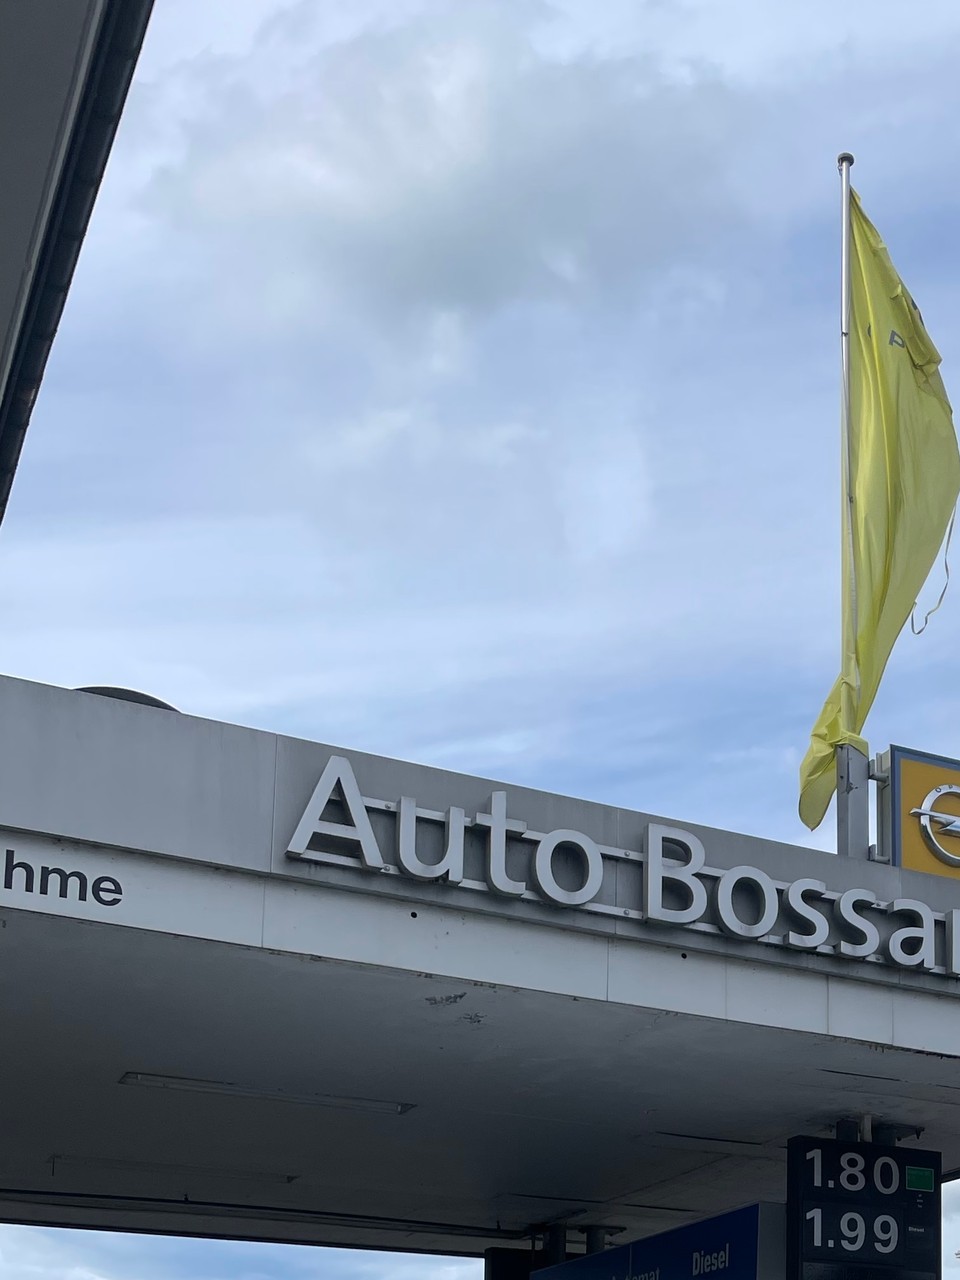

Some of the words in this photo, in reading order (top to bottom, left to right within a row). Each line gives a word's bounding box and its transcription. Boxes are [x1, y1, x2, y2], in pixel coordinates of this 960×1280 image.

[285, 755, 604, 907] Auto
[4, 849, 123, 907] hme
[806, 1148, 900, 1195] 1.80
[806, 1208, 900, 1254] 1.99
[692, 1243, 730, 1277] Diesel
